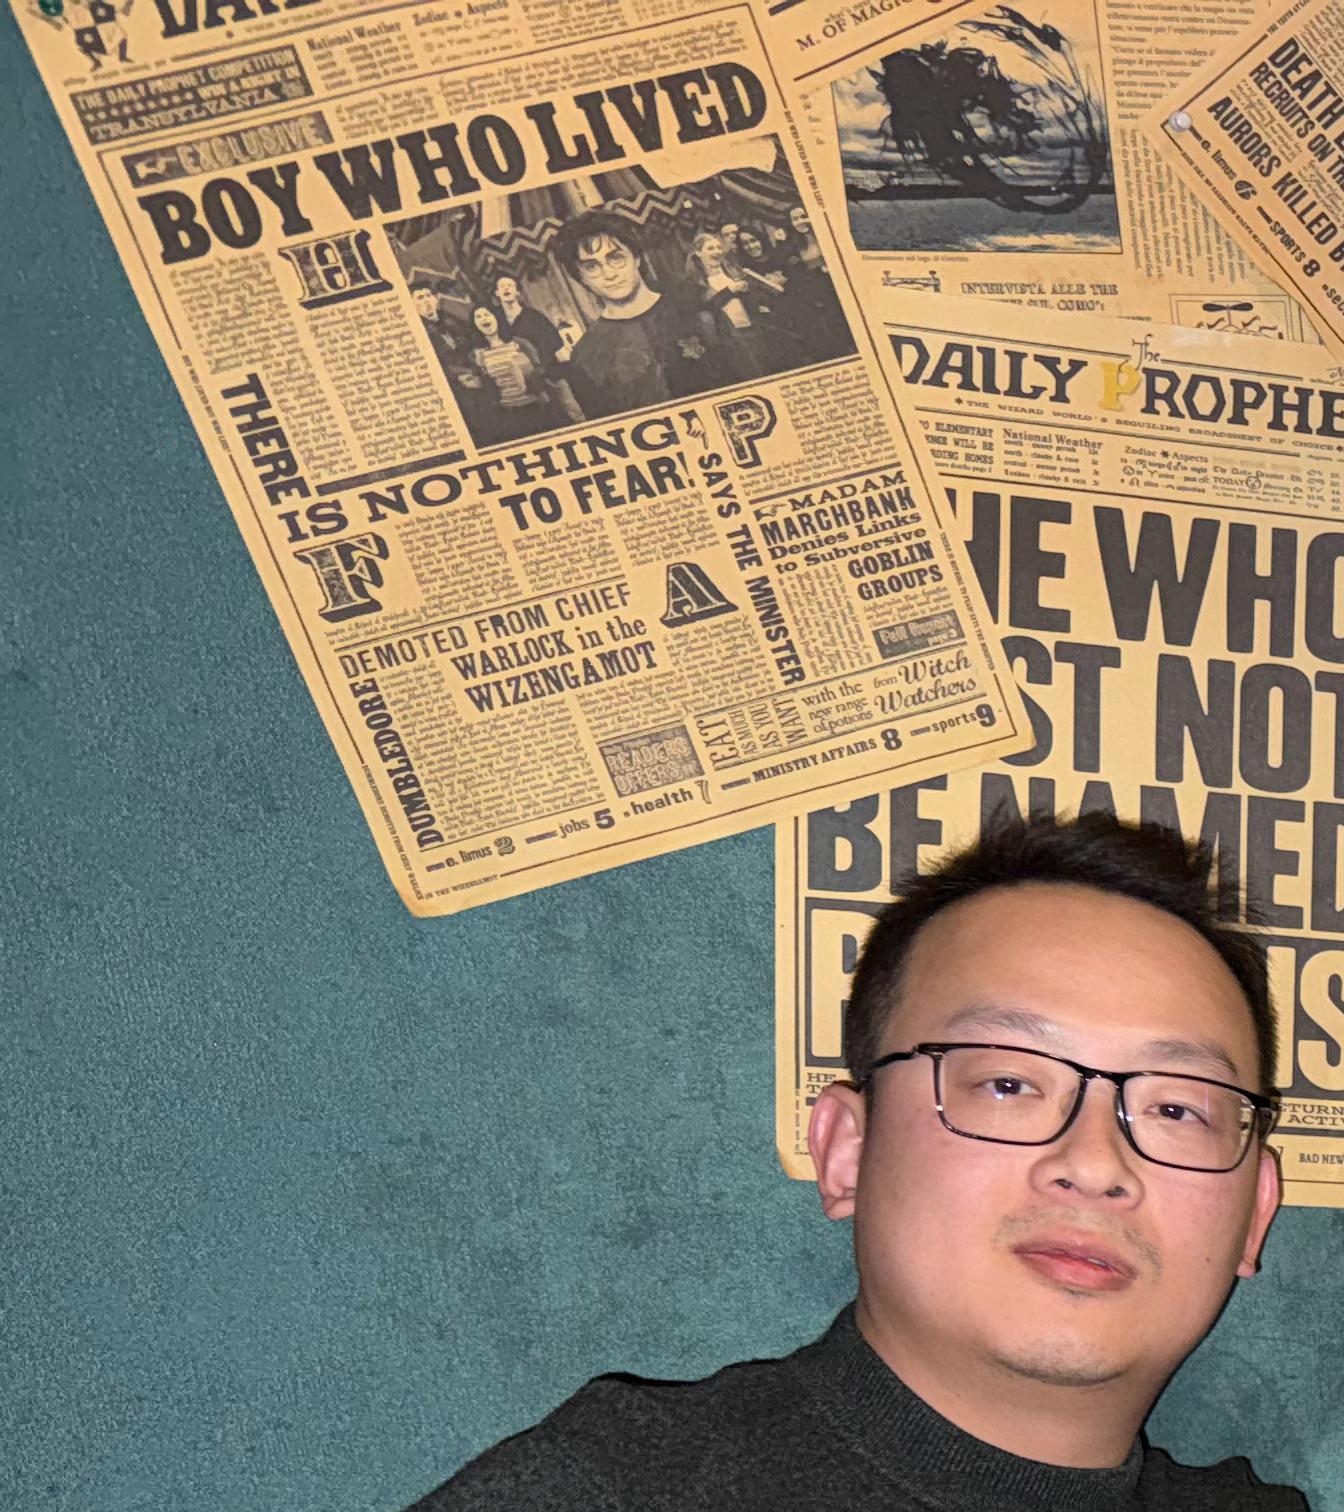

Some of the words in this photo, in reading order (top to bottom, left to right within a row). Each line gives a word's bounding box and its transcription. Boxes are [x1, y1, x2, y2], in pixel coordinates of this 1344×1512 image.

[822, 18, 848, 39] OF
[1249, 61, 1315, 139] RECRUITS
[1307, 134, 1335, 163] ON
[137, 160, 314, 266] BOY
[313, 114, 527, 222] WHO
[524, 62, 768, 175] LIVED
[174, 116, 323, 176] EXCLUSIVE
[1207, 96, 1281, 178] AURORS
[1272, 172, 1339, 246] KILLED
[1269, 221, 1306, 263] SPORTS
[1302, 259, 1321, 277] 8
[888, 332, 1088, 404] DAILY
[221, 373, 311, 506] THERE
[279, 500, 348, 543] IS
[359, 418, 682, 523] NOTHING
[498, 487, 563, 531] TO
[570, 451, 696, 515] FEAR!
[788, 470, 909, 513] MADAM
[759, 487, 917, 547] MARCHBANK
[767, 531, 849, 561] Denies
[857, 512, 922, 538] Links
[699, 453, 742, 519] SAYS
[726, 524, 763, 572] THE
[745, 576, 806, 686] MINISTER
[775, 560, 798, 575] to
[804, 527, 927, 568] Subversive
[848, 540, 936, 579] GOBLIN
[858, 564, 944, 602] GROUPS
[339, 625, 469, 679] DEMOTED
[476, 603, 550, 643] FROM
[557, 583, 632, 622] CHIEF
[450, 630, 575, 681] WARLOCK
[576, 626, 604, 651] in
[606, 615, 647, 643] the
[465, 641, 658, 713] WIZENGAMOT
[874, 677, 978, 715] Watchers
[898, 651, 973, 686] Witch
[932, 713, 978, 736] sports
[975, 703, 997, 728] 9
[350, 677, 445, 850] DUMBLEDORE
[752, 755, 821, 782] MINISTRY
[819, 739, 878, 768] AFFAIRS
[880, 728, 904, 751] 8
[560, 819, 590, 838] jobs
[595, 808, 616, 829] 5
[806, 775, 948, 893] BE
[1299, 1153, 1320, 1164] BAD
